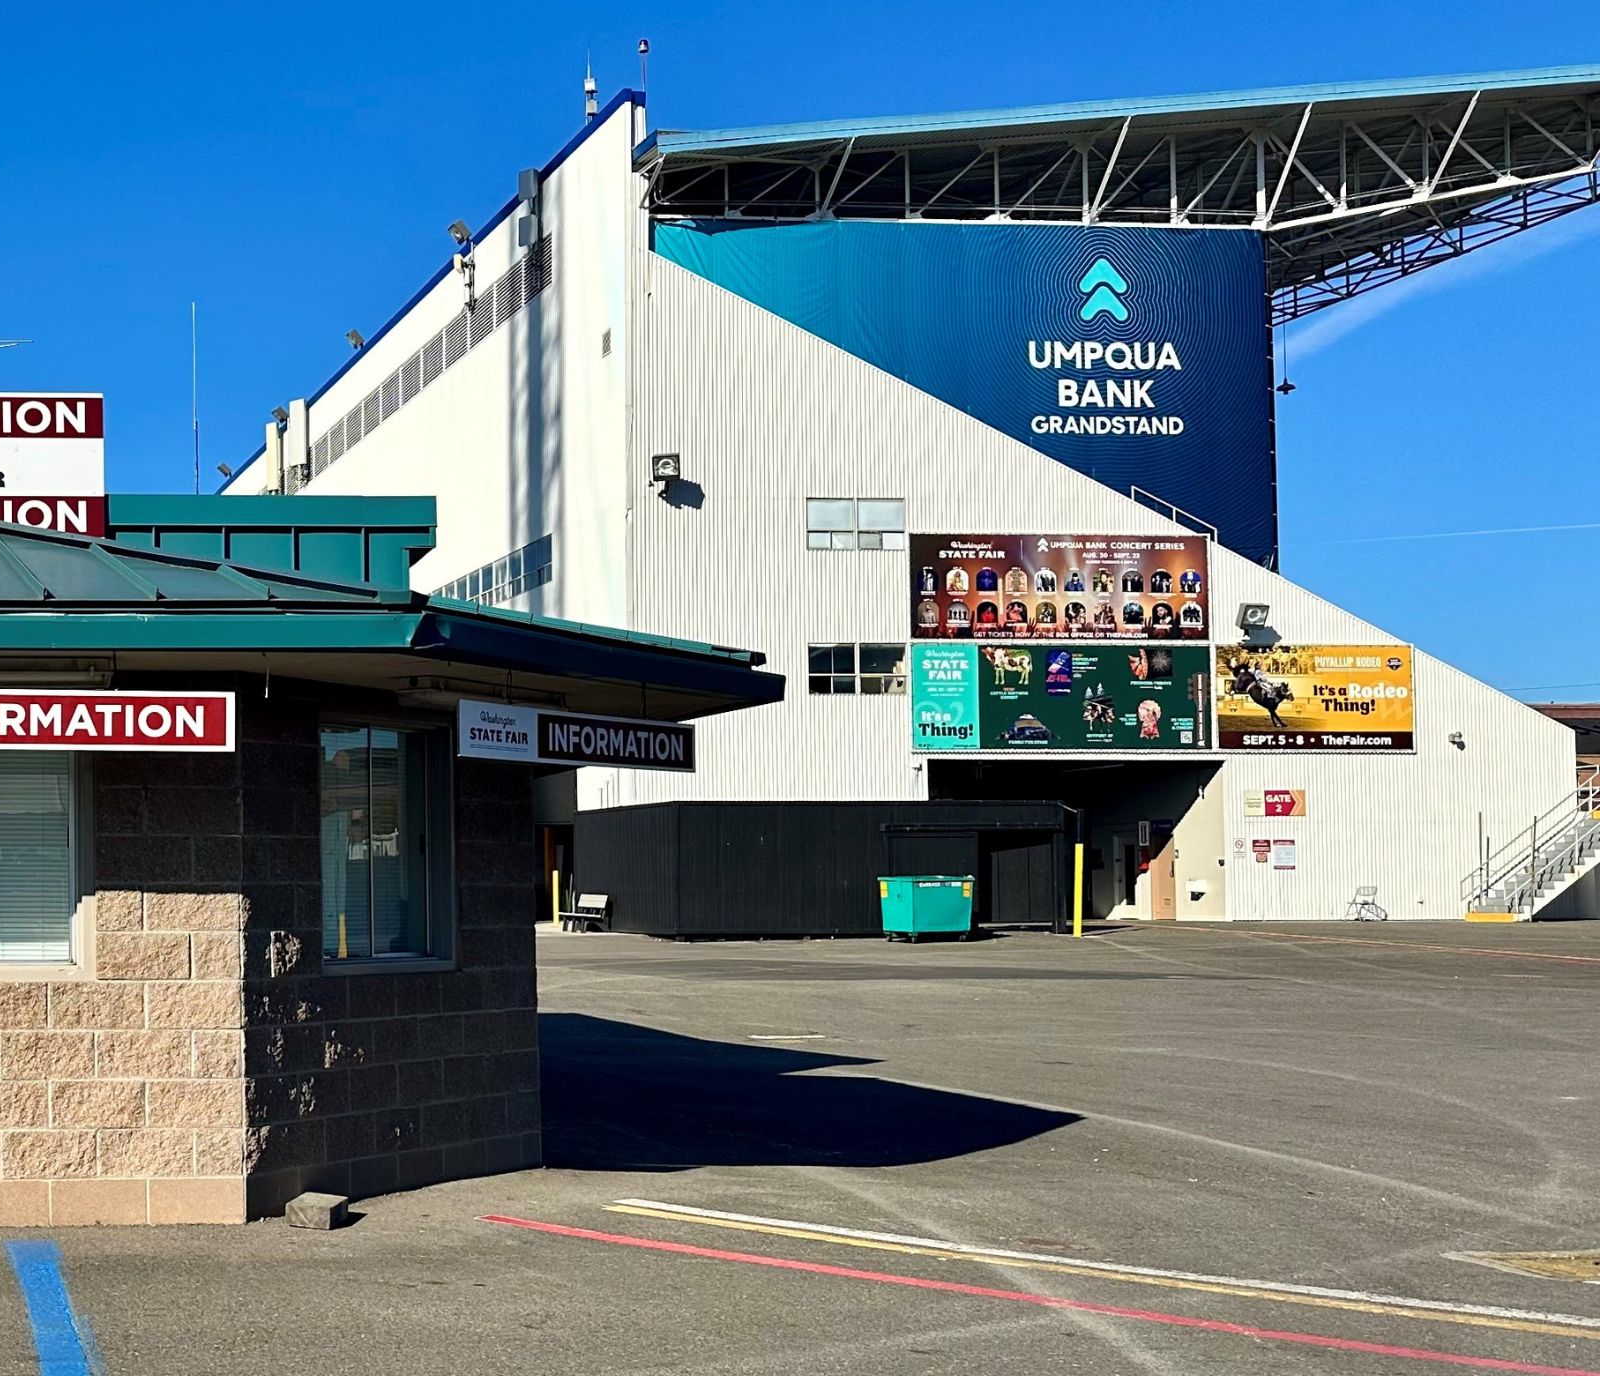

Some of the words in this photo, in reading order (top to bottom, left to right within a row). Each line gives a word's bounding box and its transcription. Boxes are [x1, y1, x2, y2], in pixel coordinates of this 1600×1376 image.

[1028, 340, 1182, 370] UMPQUA
[1057, 379, 1156, 409] BANK
[1030, 415, 1185, 436] GRANDSTAND
[1050, 541, 1083, 550] UMPQUA
[1110, 542, 1152, 551] CONCERT
[1154, 542, 1185, 550] SERIES
[938, 550, 977, 559] STATE
[978, 550, 1006, 559] FAIR
[922, 659, 969, 669] STATE
[1314, 656, 1354, 668] PUYALLUP
[1355, 657, 1382, 668] RODEO
[928, 670, 962, 680] FAIR
[1313, 684, 1336, 697] It's
[1337, 687, 1347, 696] a
[1348, 682, 1408, 699] Rodeo
[1321, 699, 1376, 716] Thing!
[921, 710, 942, 722] It's
[942, 712, 952, 721] a
[469, 727, 503, 742] STATE
[505, 730, 529, 745] FAIR
[918, 722, 974, 740] Thing!
[549, 722, 684, 761] INFORMATION
[1242, 735, 1276, 746] SEPT.
[1278, 736, 1286, 746] 5
[1295, 735, 1305, 746] 8
[1321, 735, 1392, 746] TheFair.com
[1275, 804, 1282, 812] 2
